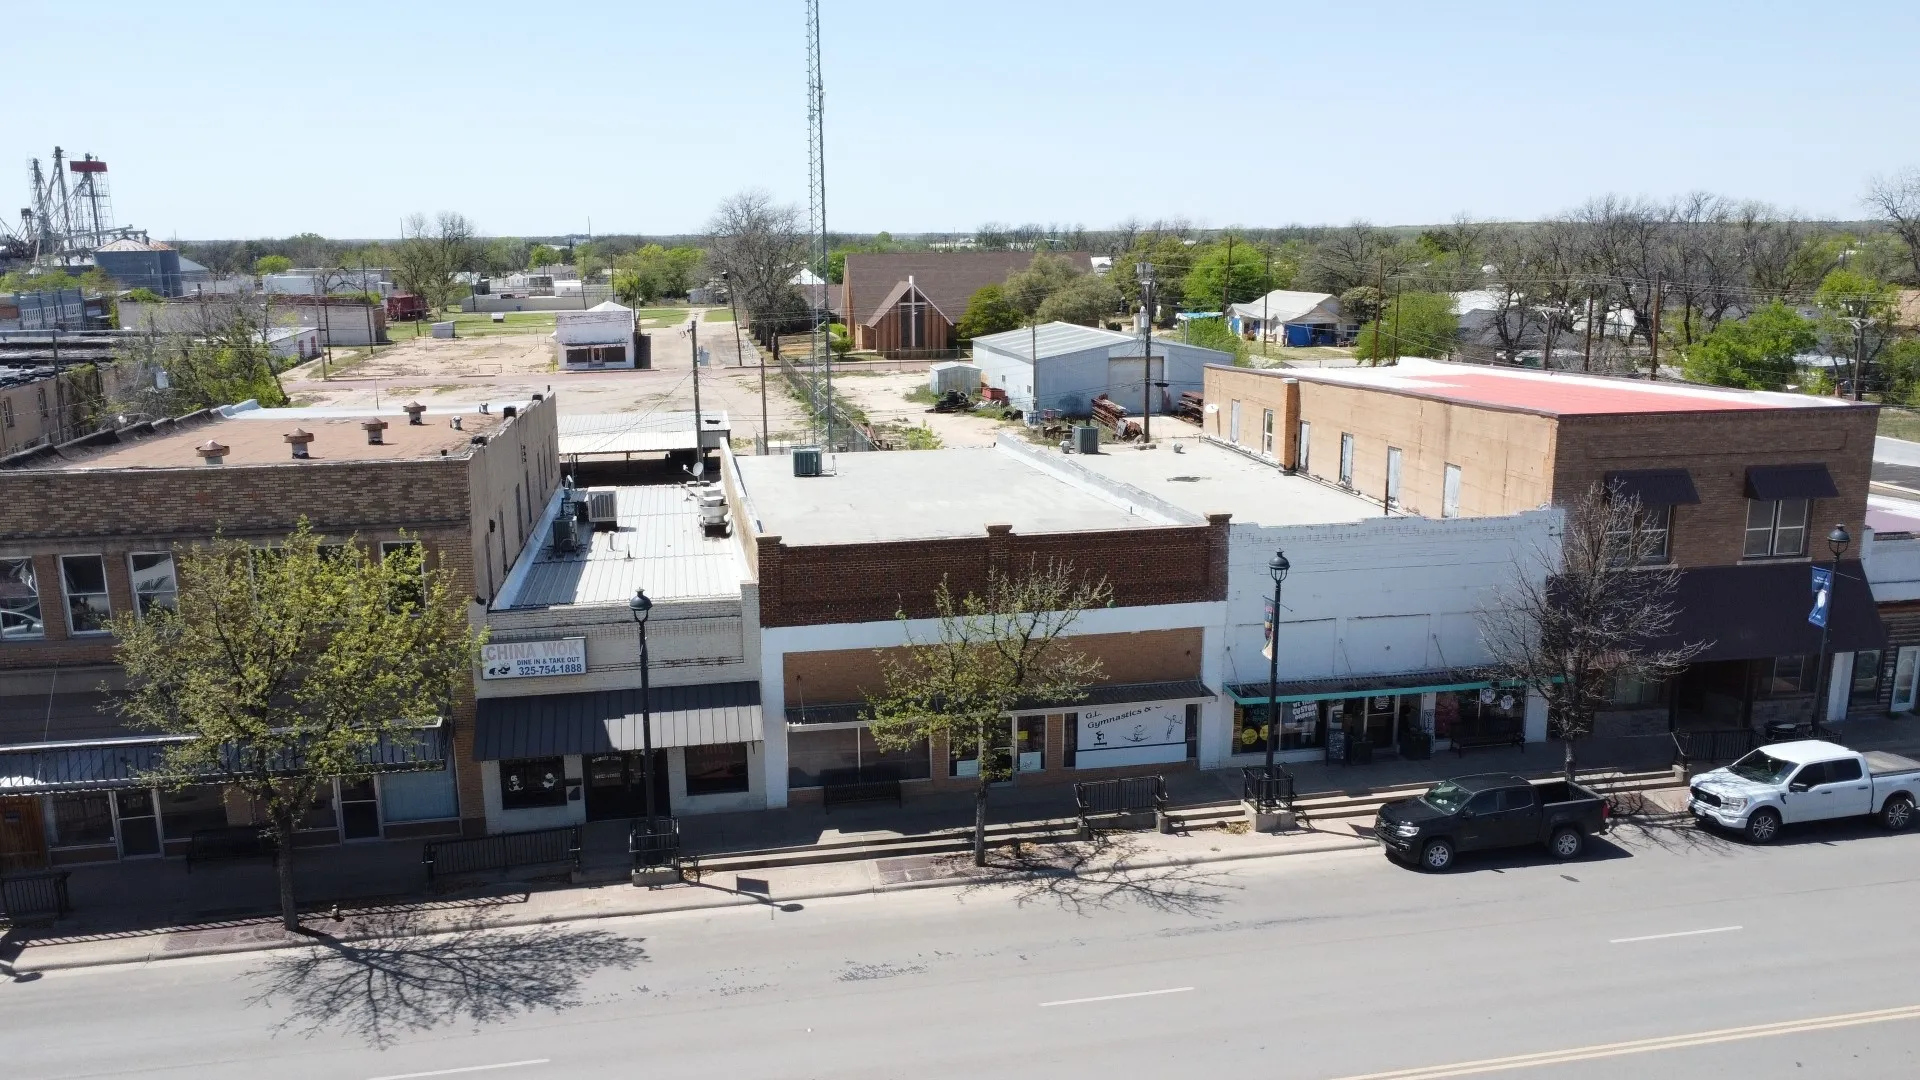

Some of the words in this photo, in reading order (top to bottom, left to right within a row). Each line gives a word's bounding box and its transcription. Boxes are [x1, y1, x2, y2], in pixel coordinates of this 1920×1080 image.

[486, 643, 535, 661] CHINA
[542, 641, 580, 656] WOK
[519, 664, 582, 675] 325-754-1888
[1292, 704, 1317, 715] CUSTOM
[1088, 709, 1142, 728] Gymnastics
